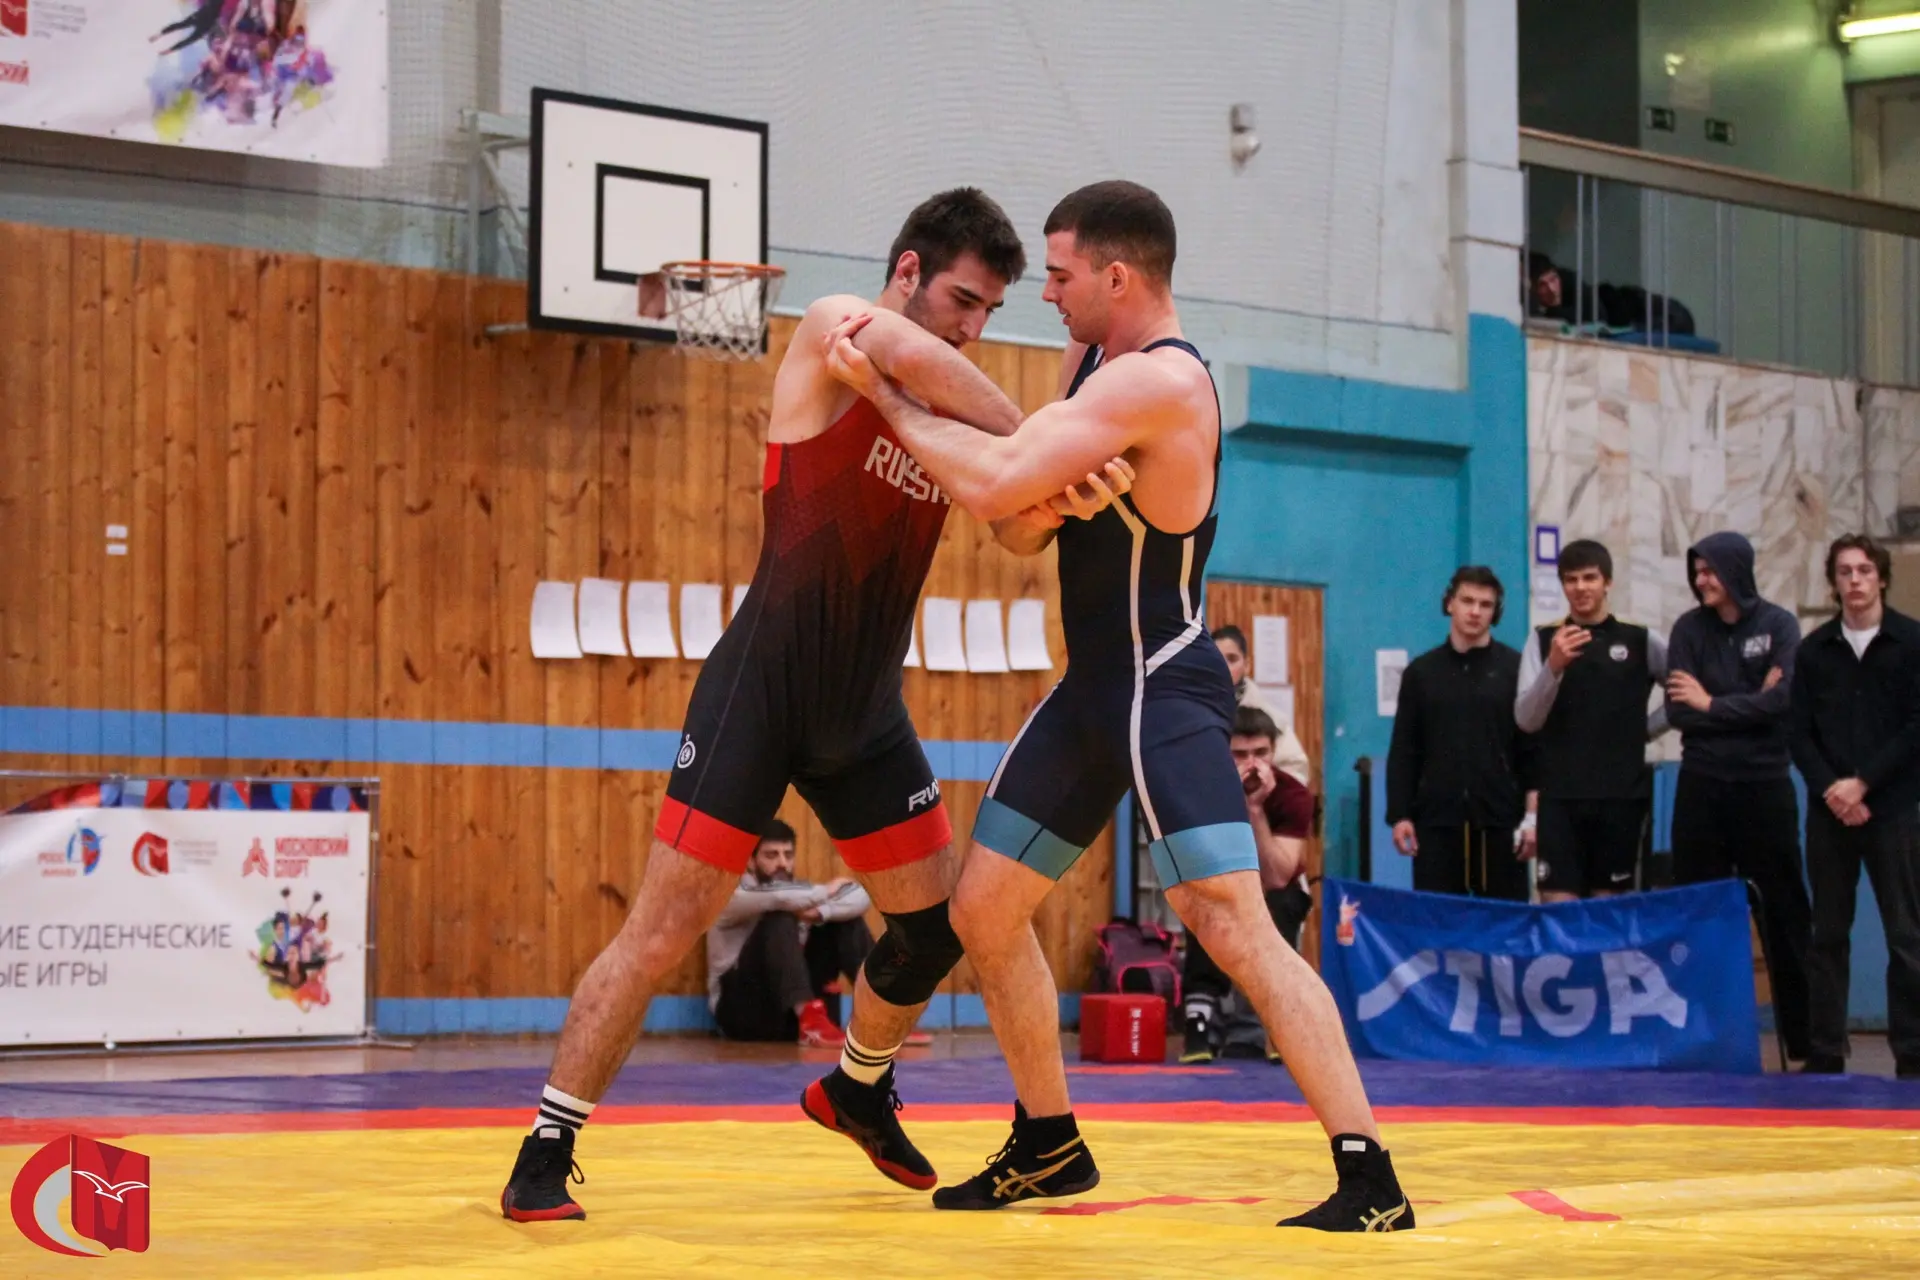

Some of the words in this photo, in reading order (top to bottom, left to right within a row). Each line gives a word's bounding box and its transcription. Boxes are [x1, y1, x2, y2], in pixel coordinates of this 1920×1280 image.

[37, 923, 232, 953] СТУДЕНЧЕСКИЕ
[37, 961, 108, 988] ИГРЫ
[1356, 948, 1688, 1038] STIGA
